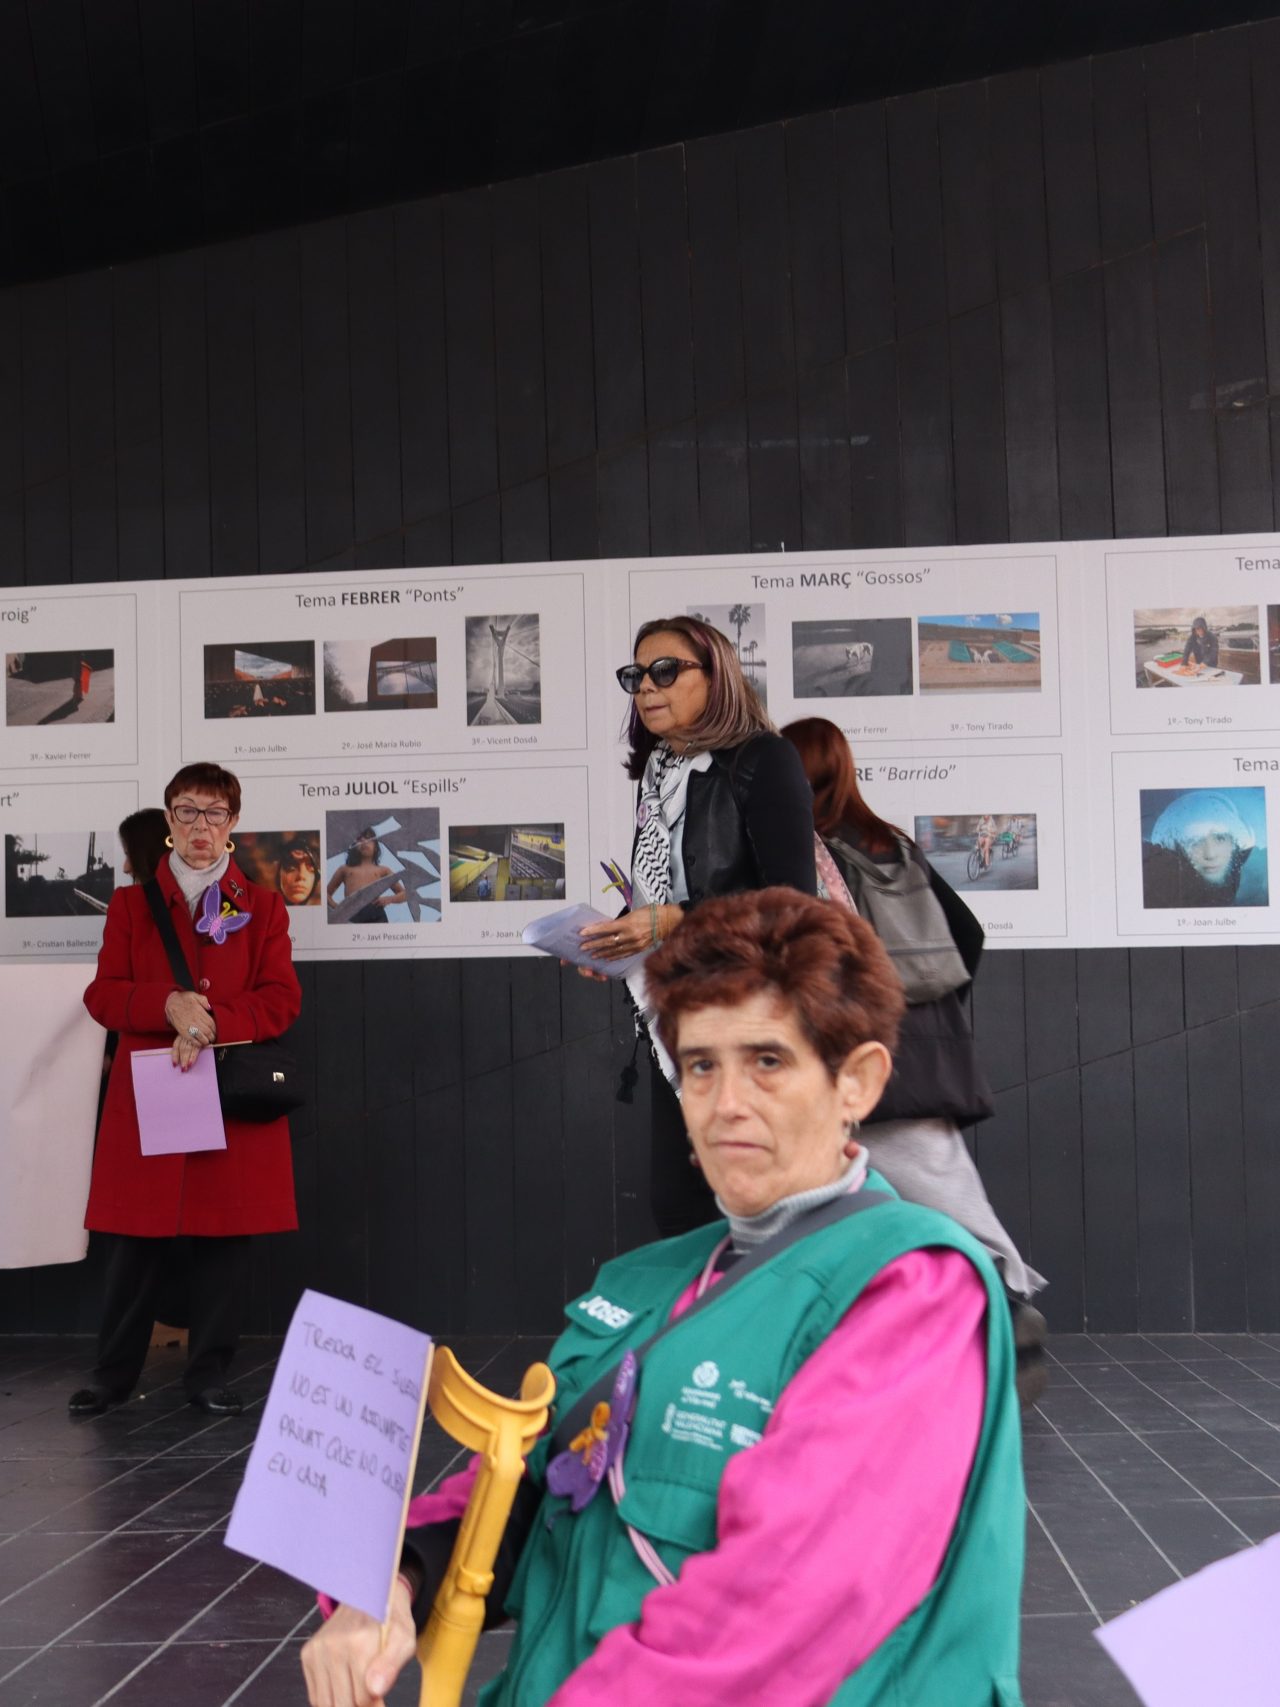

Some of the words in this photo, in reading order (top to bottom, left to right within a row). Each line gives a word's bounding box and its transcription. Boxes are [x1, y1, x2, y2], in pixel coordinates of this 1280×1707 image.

[1235, 557, 1280, 571] Tema
[751, 575, 794, 589] Tema
[800, 572, 851, 589] MARÇ
[295, 594, 336, 608] Tema
[341, 590, 401, 605] FEBRER
[1184, 717, 1203, 726] Tony
[1206, 716, 1232, 724] Tirado
[839, 727, 862, 735] avier
[864, 726, 888, 734] Ferrer
[966, 723, 985, 732] Tony
[988, 722, 1014, 731] Tirado
[400, 739, 421, 748] Rubio
[487, 737, 512, 746] Vicent
[248, 745, 267, 754] Joan
[69, 752, 91, 760] Ferrer
[1233, 758, 1279, 772] Tema
[299, 783, 340, 797] Tema
[345, 781, 398, 796] JULIOL
[1193, 918, 1213, 927] Joan
[382, 932, 417, 941] Pescador
[496, 930, 514, 938] Joan
[66, 939, 98, 948] Ballester
